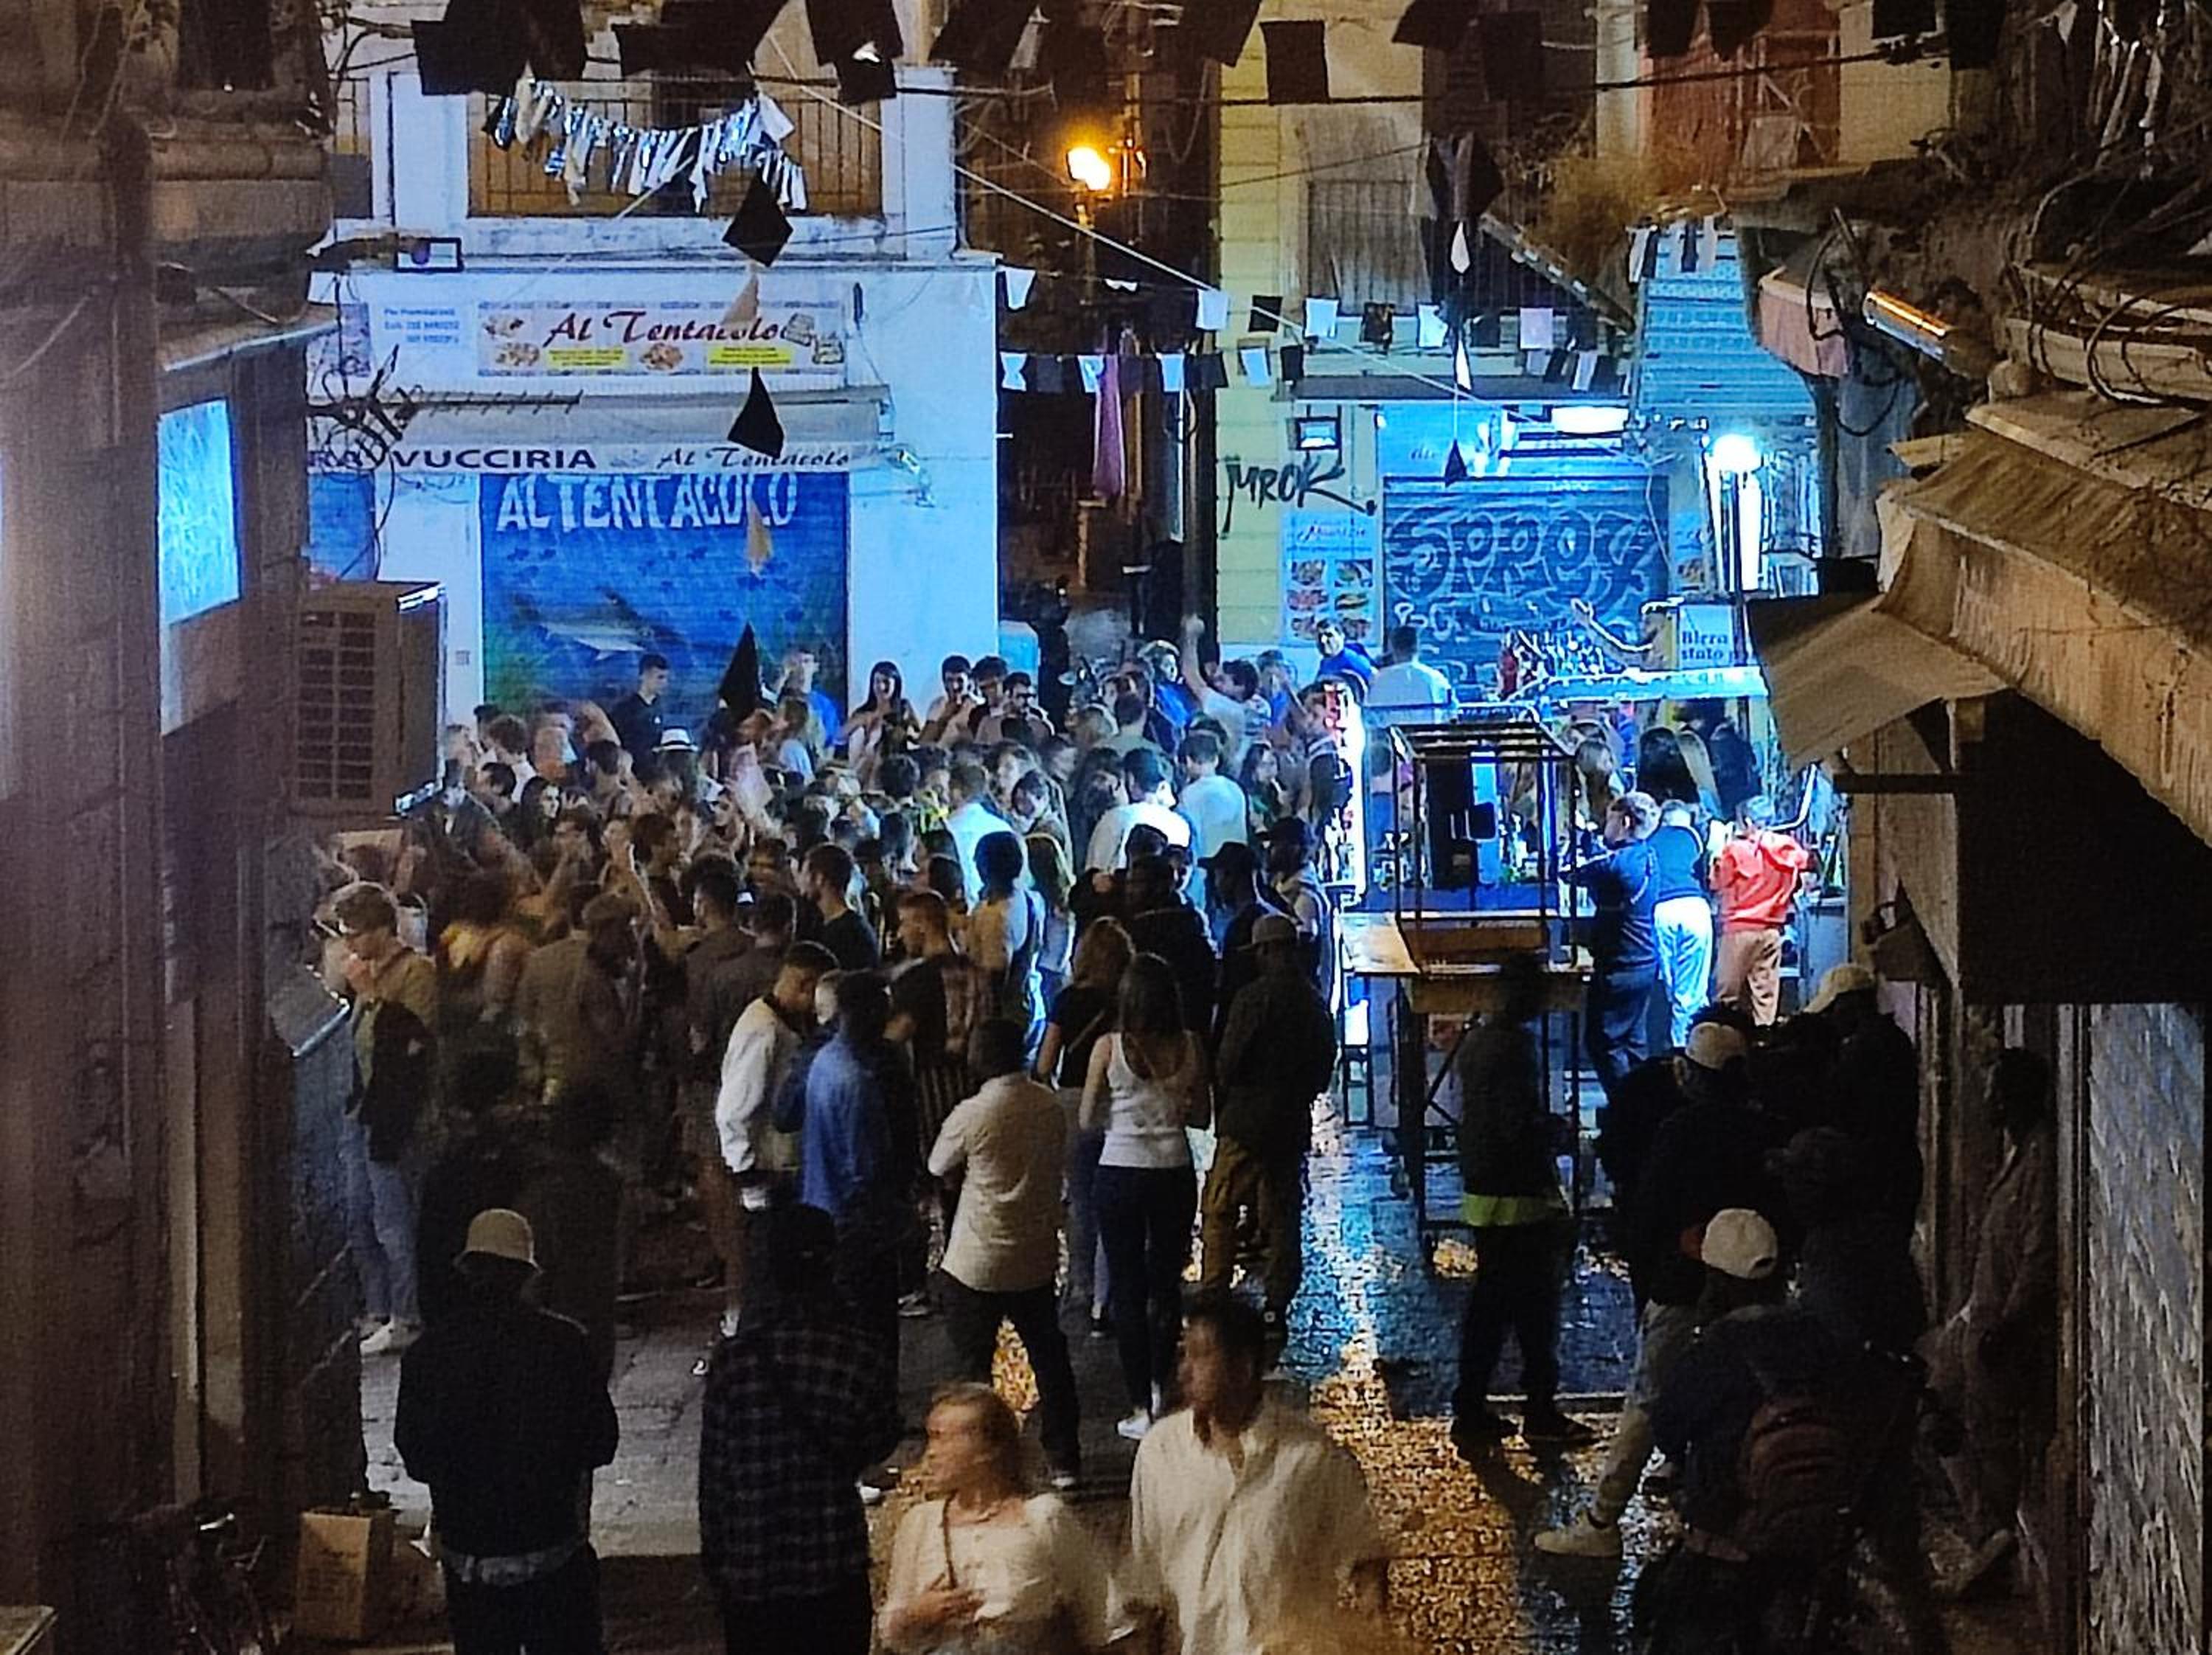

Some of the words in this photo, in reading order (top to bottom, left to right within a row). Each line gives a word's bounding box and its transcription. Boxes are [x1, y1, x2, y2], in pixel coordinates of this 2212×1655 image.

[542, 311, 592, 348] Al
[602, 310, 779, 343] Tentacolo
[392, 448, 597, 468] VUCCIRIA
[495, 473, 552, 531] AL
